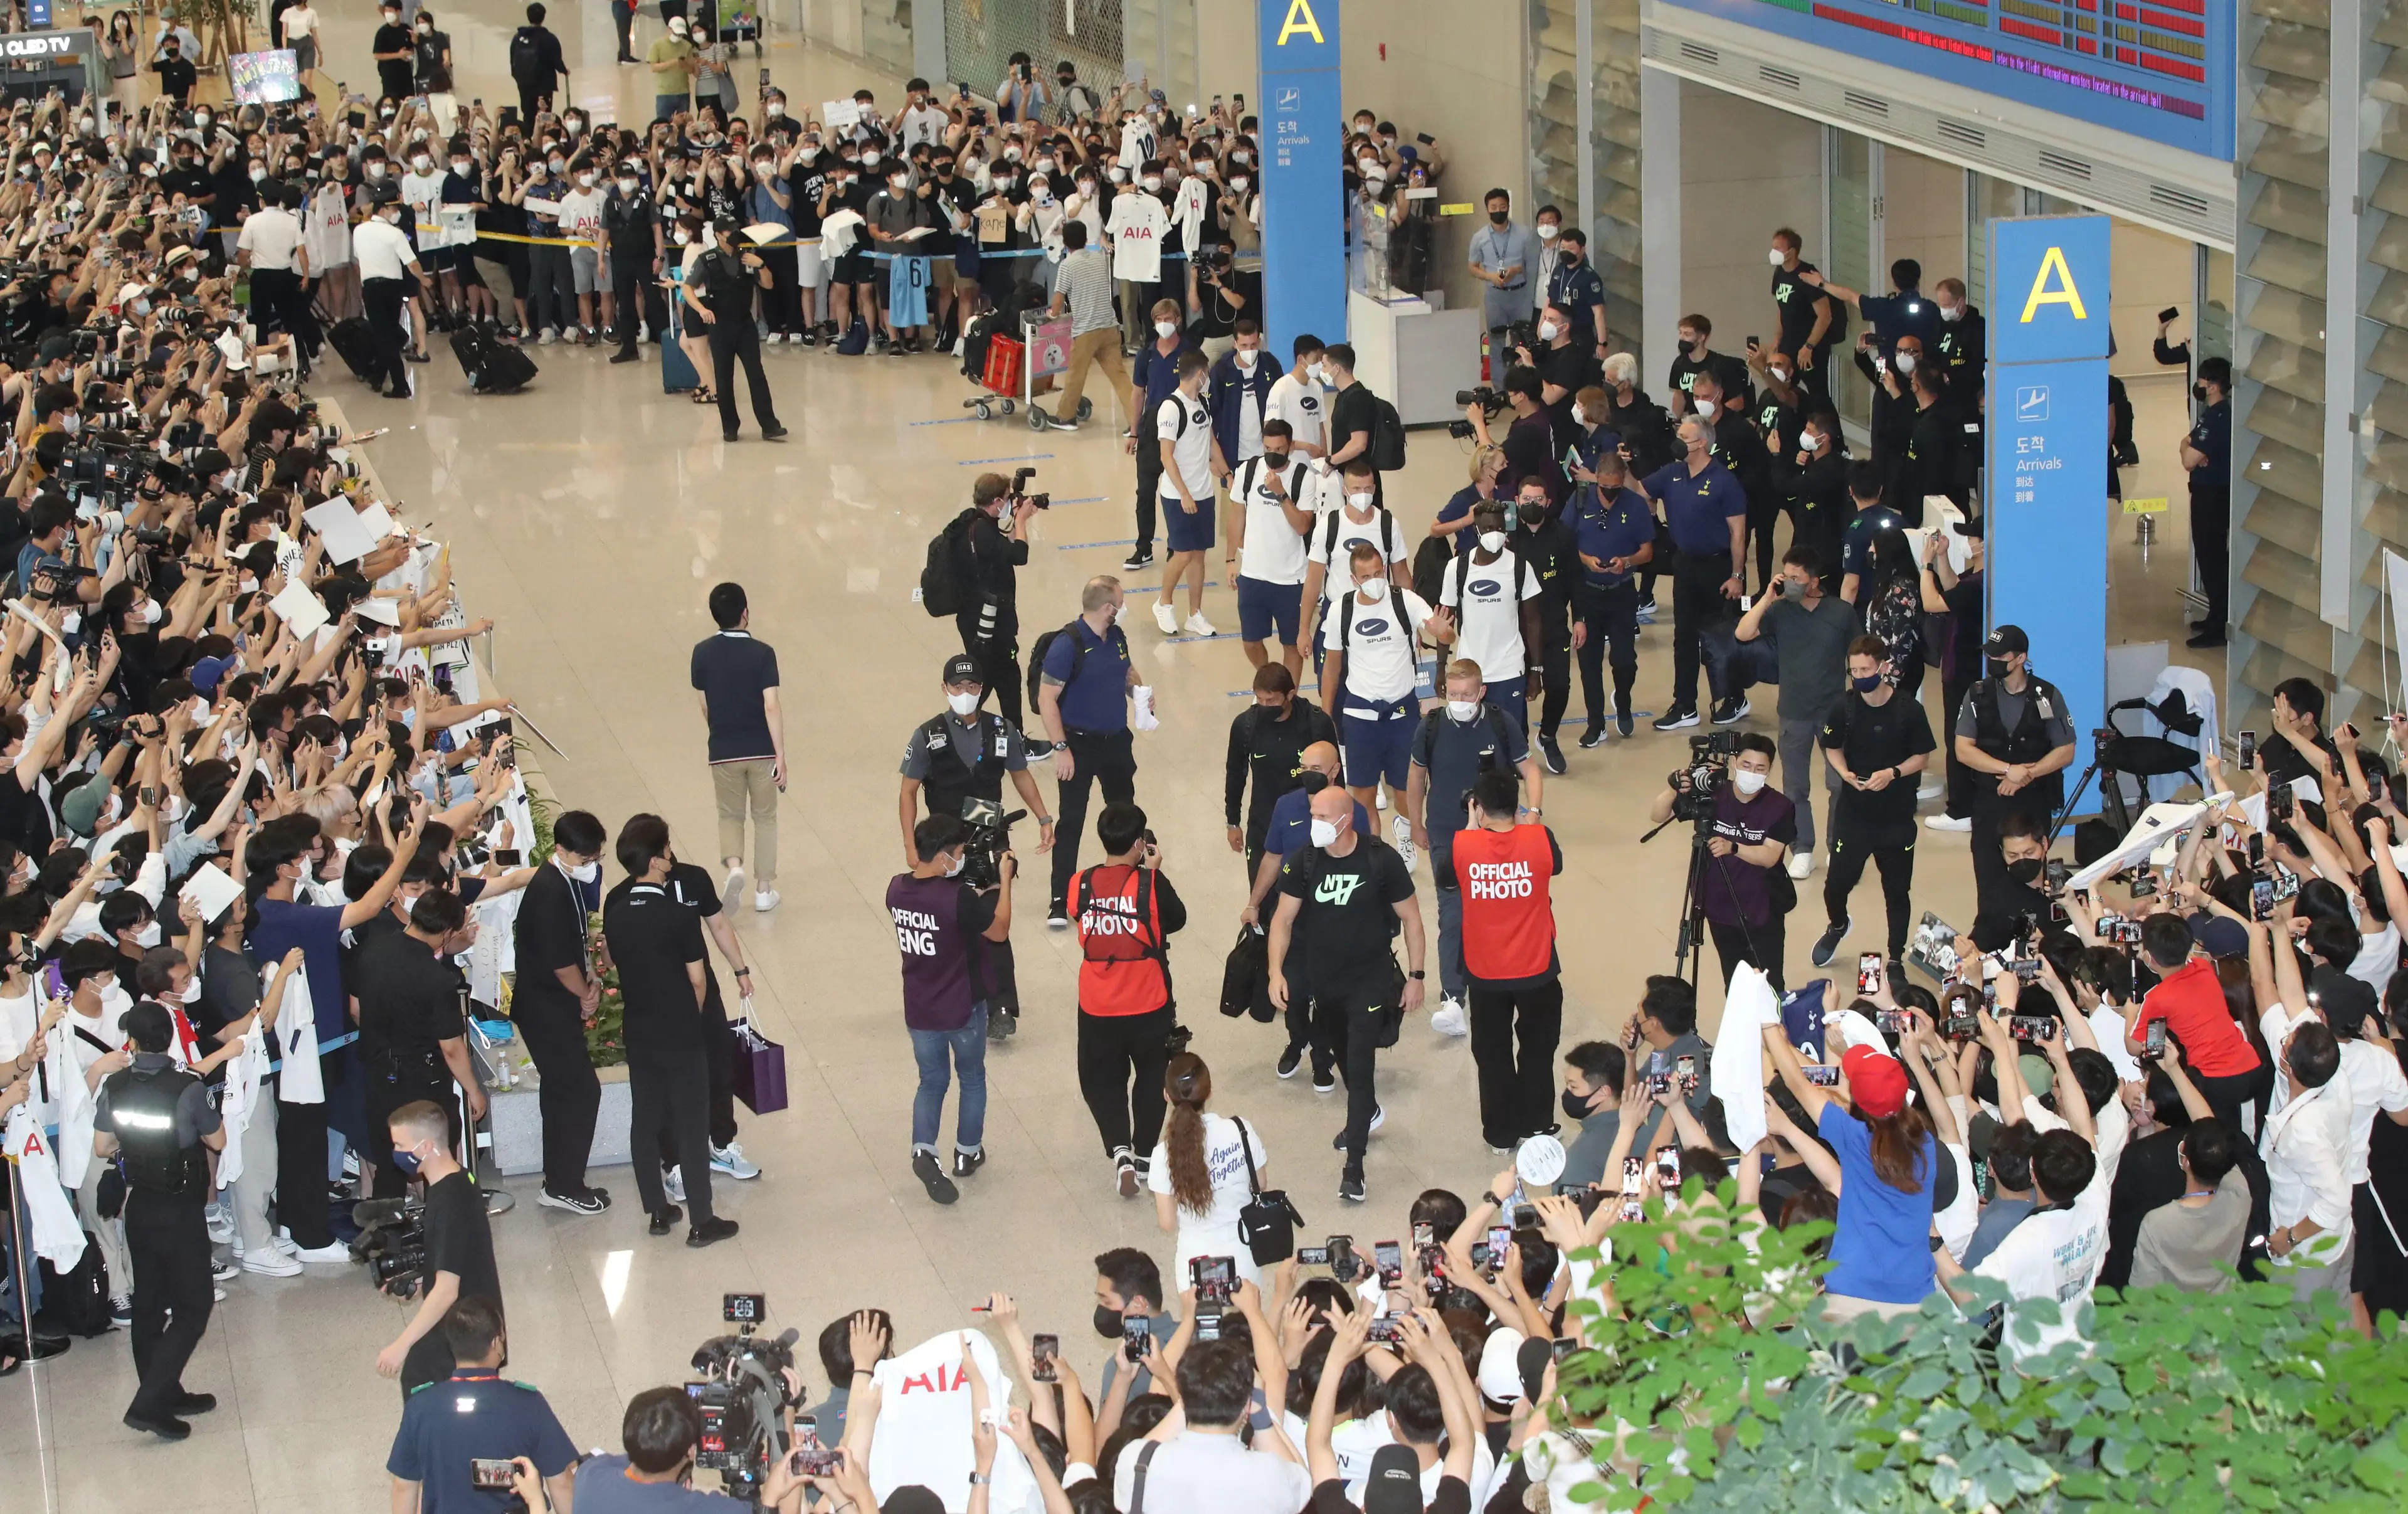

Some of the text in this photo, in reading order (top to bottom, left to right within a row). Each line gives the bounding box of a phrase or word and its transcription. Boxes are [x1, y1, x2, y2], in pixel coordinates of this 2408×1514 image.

[1277, 0, 1324, 45] A
[7, 36, 70, 56] OLED TV
[1996, 52, 2008, 67] refer
[2010, 57, 2015, 68] to
[2016, 58, 2024, 71] the
[2026, 60, 2040, 76] flight
[2042, 64, 2069, 83] information
[2070, 71, 2090, 89] monitors
[2093, 77, 2111, 94] located
[2113, 83, 2118, 96] in
[2120, 85, 2128, 100] the
[2130, 89, 2148, 105] arrival
[1277, 120, 1297, 134] 도착
[1136, 133, 1154, 162] 10
[1277, 134, 1309, 146] Arrivals
[327, 213, 344, 228] AIA
[577, 215, 600, 228] AIA
[1123, 227, 1153, 239] AIA
[910, 258, 922, 289] 6
[2020, 247, 2087, 323] A
[2016, 436, 2045, 454] 도착
[2016, 456, 2062, 472] Arrivals
[2015, 477, 2034, 488] 到达
[2015, 491, 2034, 504] 到着
[1543, 569, 1557, 580] getir
[1366, 636, 1391, 644] SPURS
[1469, 861, 1533, 879] OFFICIAL
[1471, 879, 1532, 899] PHOTO
[891, 907, 940, 931] OFFICIAL
[1082, 914, 1139, 936] PHOTO
[897, 927, 936, 956] ENG
[23, 1133, 44, 1157] A
[1210, 1141, 1242, 1165] Again
[2054, 1240, 2074, 1257] WORK
[2078, 1234, 2084, 1246] &
[900, 1362, 969, 1395] AIA
